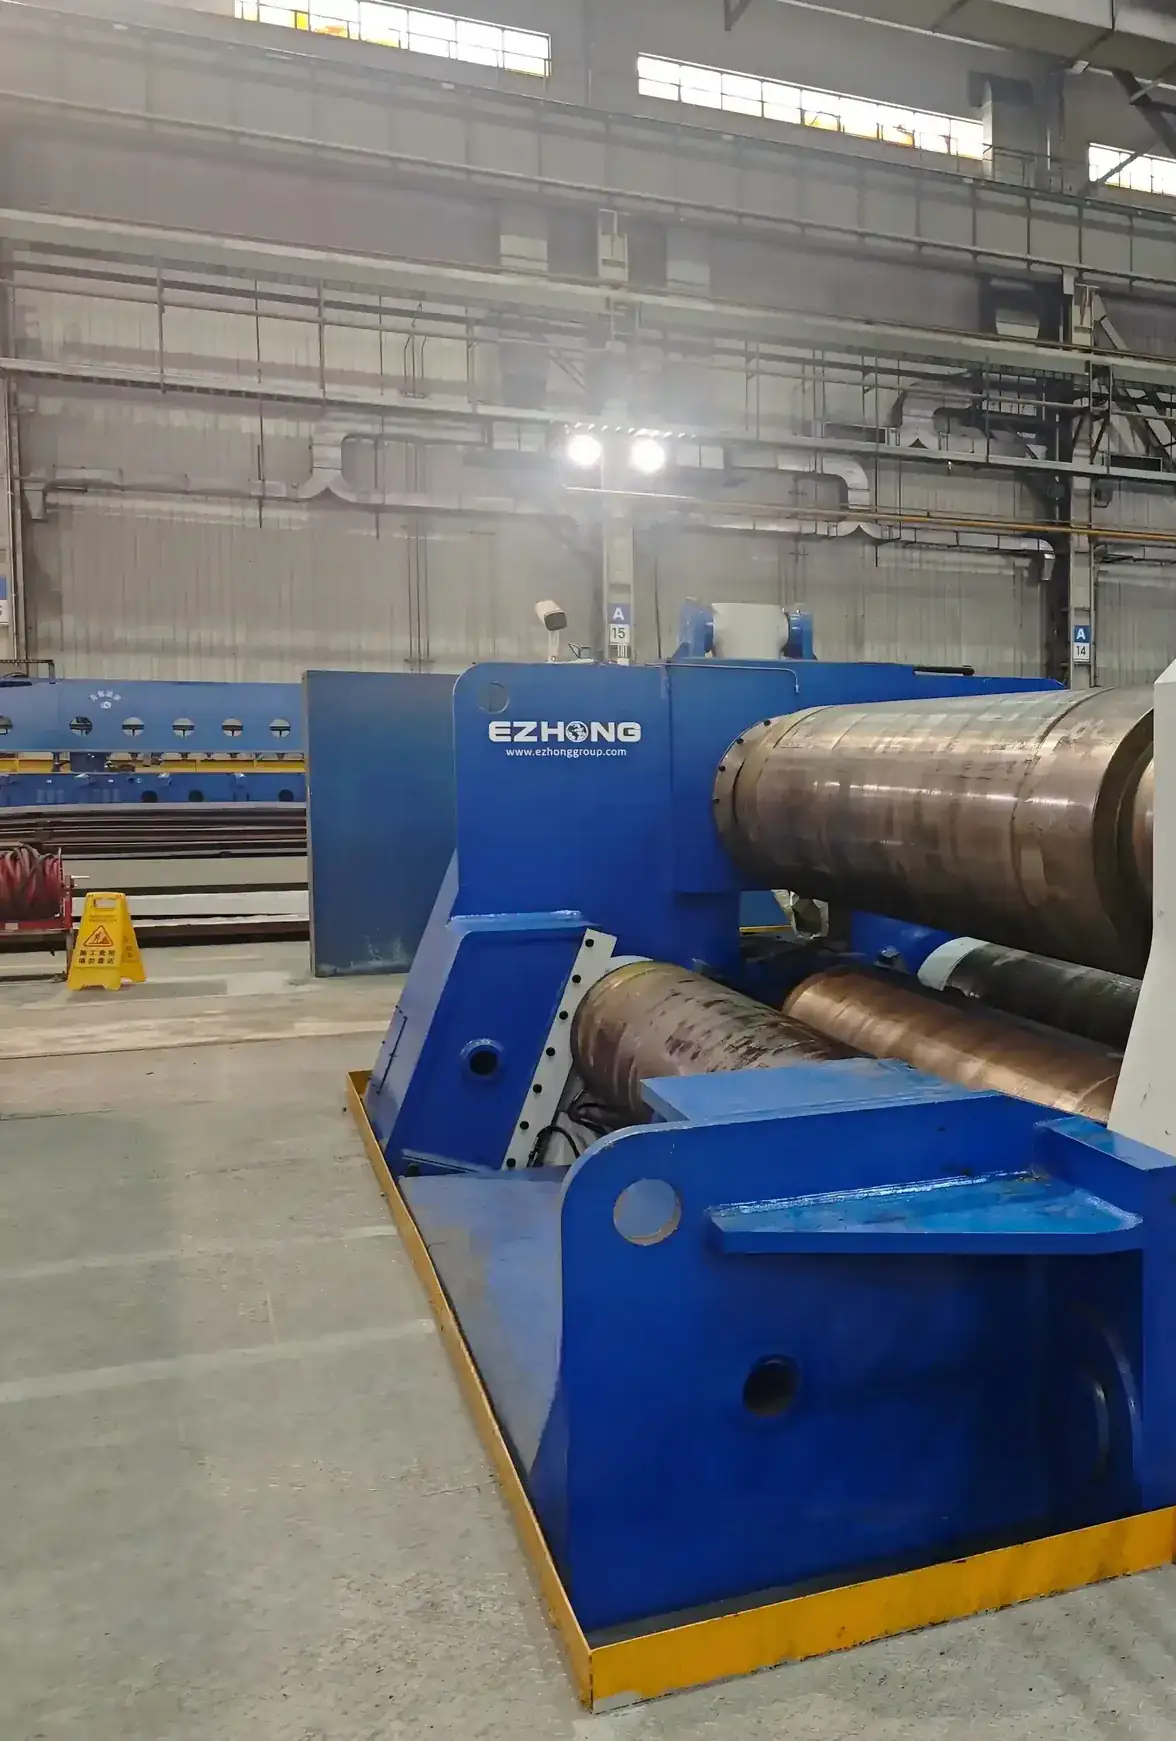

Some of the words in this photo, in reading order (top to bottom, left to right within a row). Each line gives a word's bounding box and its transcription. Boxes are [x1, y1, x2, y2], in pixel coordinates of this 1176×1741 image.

[612, 607, 625, 620] A
[611, 627, 626, 640] 15
[1076, 628, 1086, 640] A
[1076, 645, 1086, 656] 14
[488, 720, 642, 743] EZHONG
[505, 746, 627, 758] www.ezhonggroup.com
